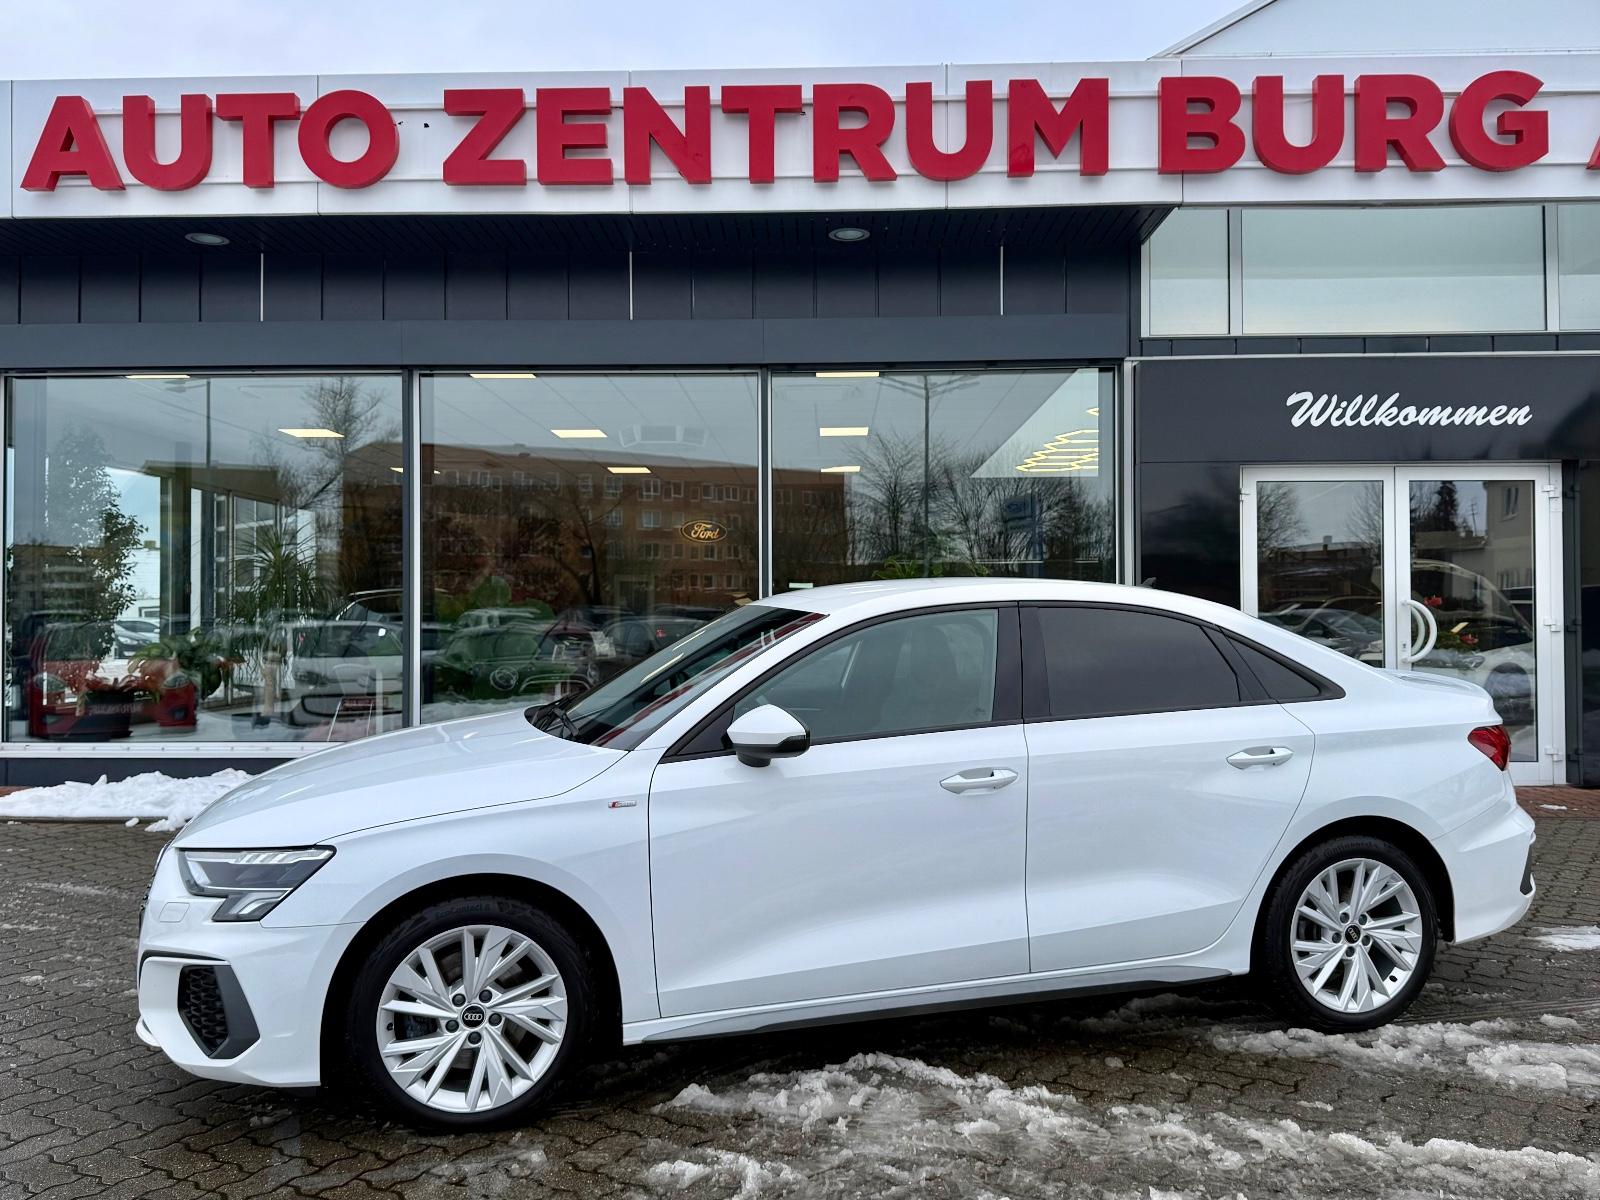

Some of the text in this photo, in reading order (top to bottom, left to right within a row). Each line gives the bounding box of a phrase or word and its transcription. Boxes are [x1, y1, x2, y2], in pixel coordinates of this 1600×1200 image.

[21, 70, 1549, 191] AUTO ZENTRUM BURG
[1286, 391, 1533, 427] Willkommen
[690, 522, 720, 539] Ford
